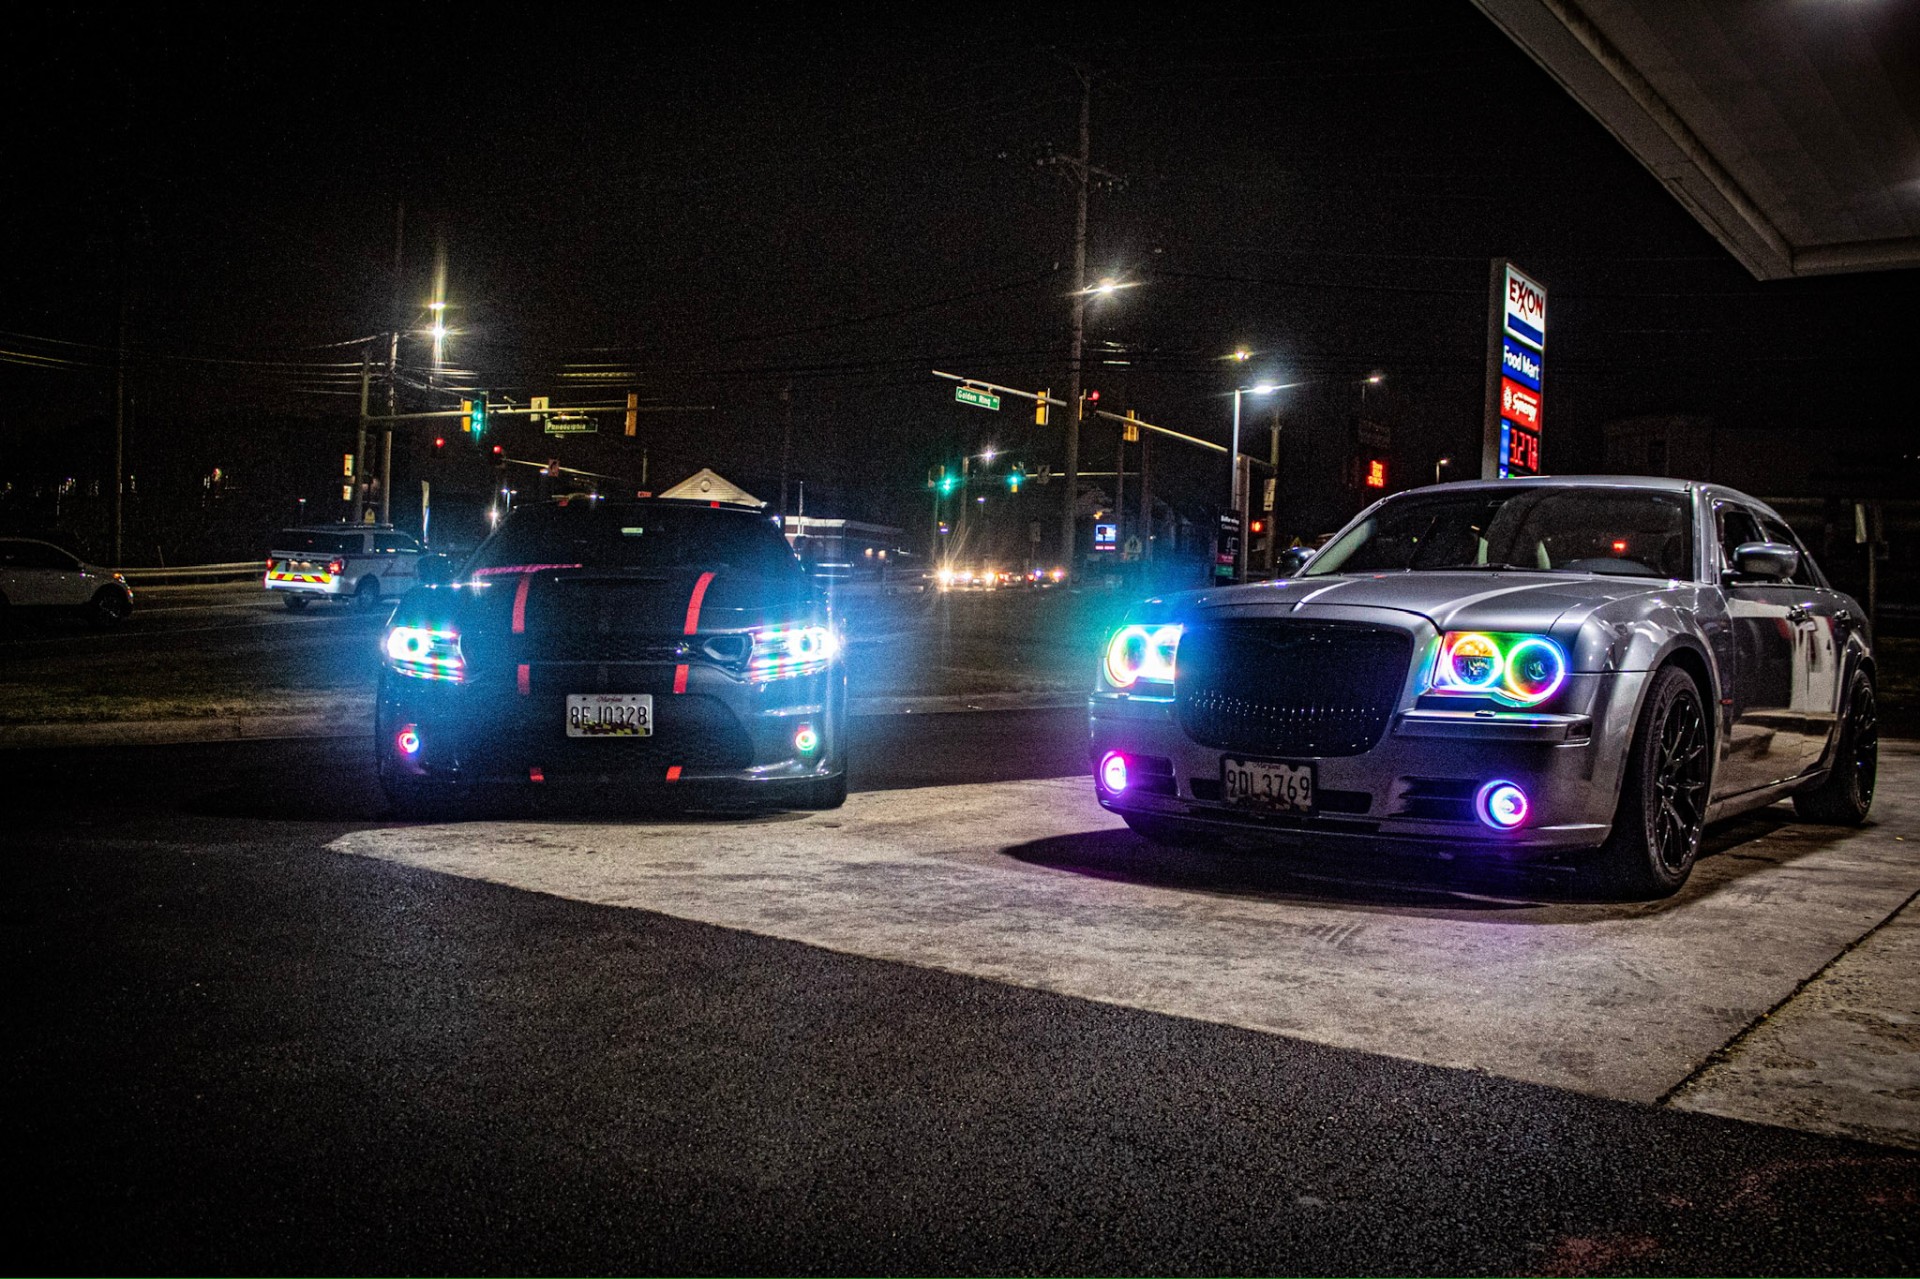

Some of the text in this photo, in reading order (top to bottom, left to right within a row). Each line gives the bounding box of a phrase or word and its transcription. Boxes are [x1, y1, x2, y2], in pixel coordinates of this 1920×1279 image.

[1510, 278, 1543, 319] EXXON
[1504, 346, 1539, 380] Food Mart
[1227, 769, 1309, 800] 9DL3769
